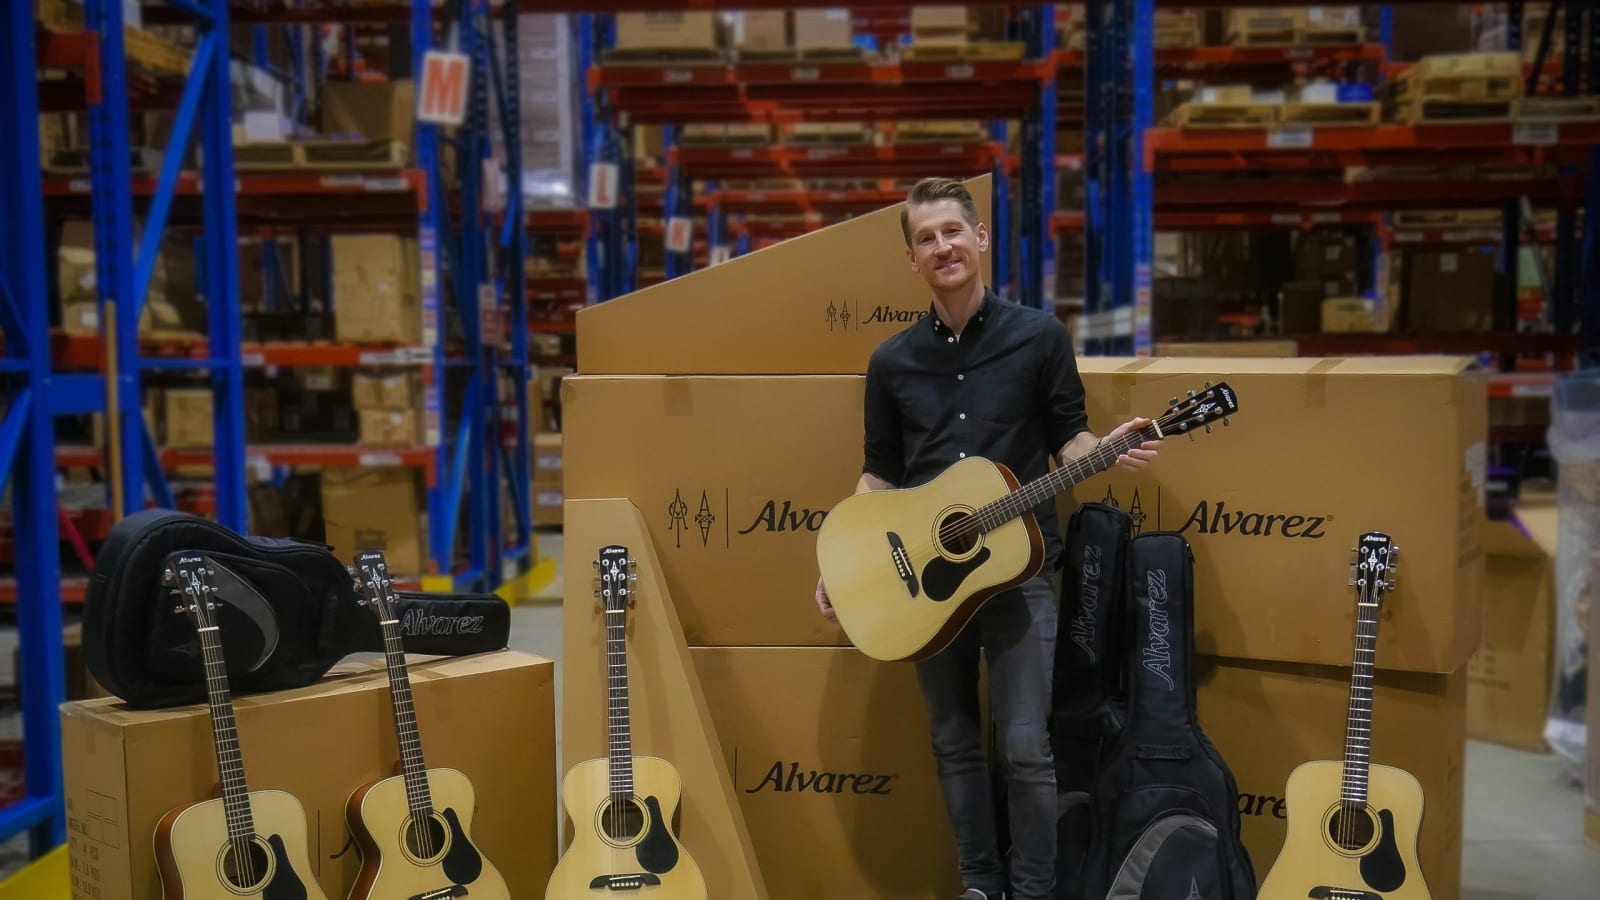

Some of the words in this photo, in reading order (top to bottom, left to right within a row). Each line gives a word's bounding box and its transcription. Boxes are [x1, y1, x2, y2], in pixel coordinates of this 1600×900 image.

[424, 57, 465, 116] M
[862, 305, 928, 324] Alvare
[738, 500, 830, 534] Alva
[1071, 544, 1101, 664] Alvarez
[400, 608, 484, 635] Alvarez
[1143, 569, 1175, 691] Alvarez
[746, 761, 892, 795] Alvarez
